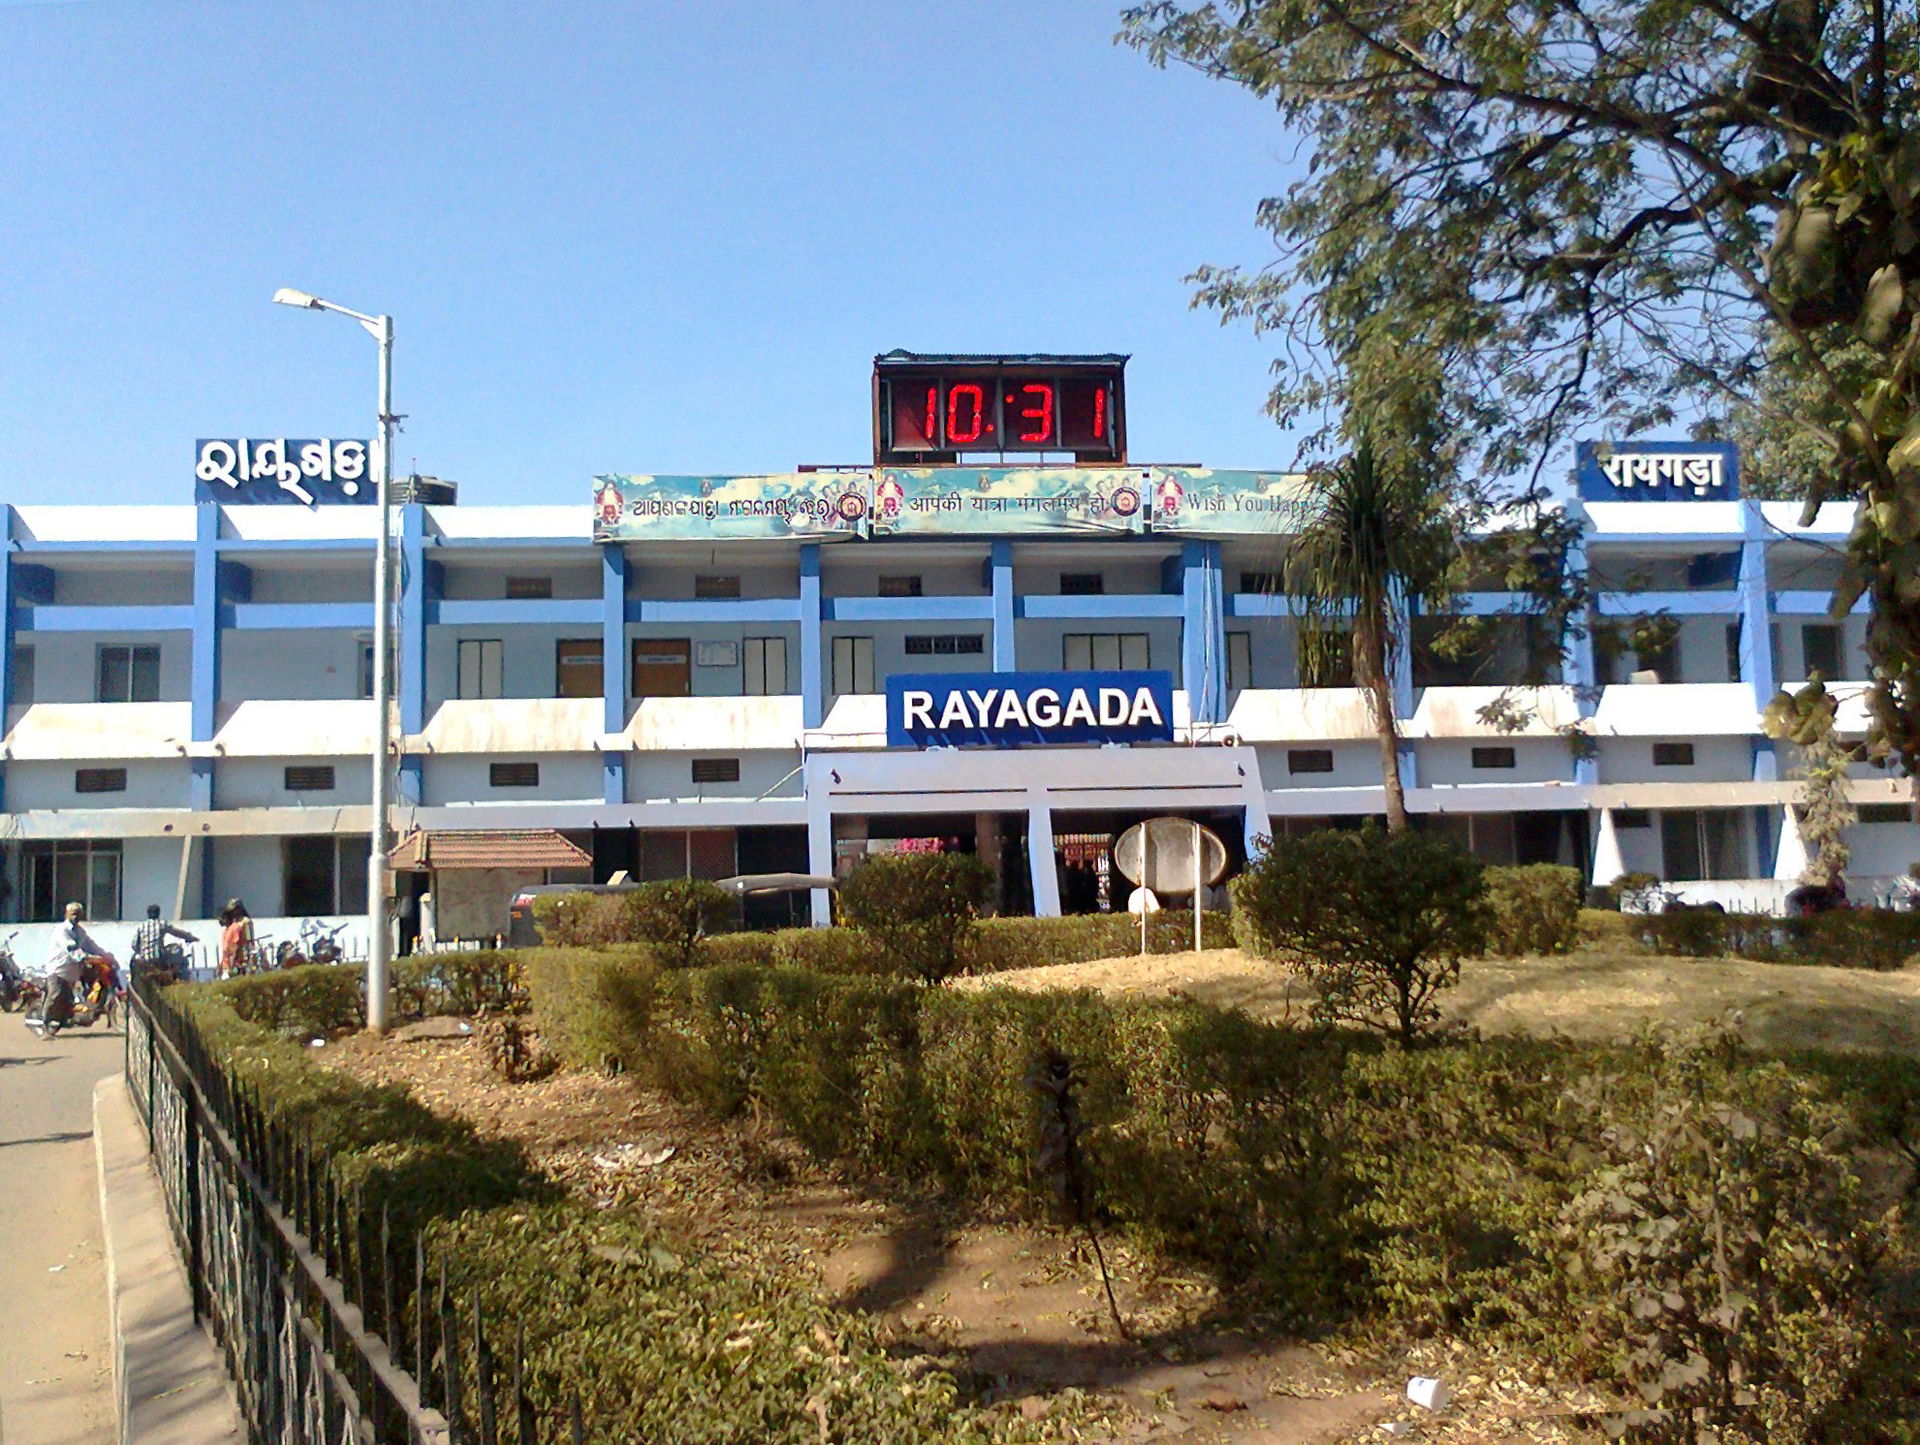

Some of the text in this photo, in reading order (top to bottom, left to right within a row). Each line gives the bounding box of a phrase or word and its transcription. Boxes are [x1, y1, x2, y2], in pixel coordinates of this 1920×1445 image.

[1597, 453, 1723, 496] रायगड़ा
[910, 491, 1105, 515] आपकी यात्रा मंगलमय हो
[1187, 493, 1226, 511] Wish
[1233, 493, 1263, 512] You
[903, 687, 1163, 729] RAYAGADA
